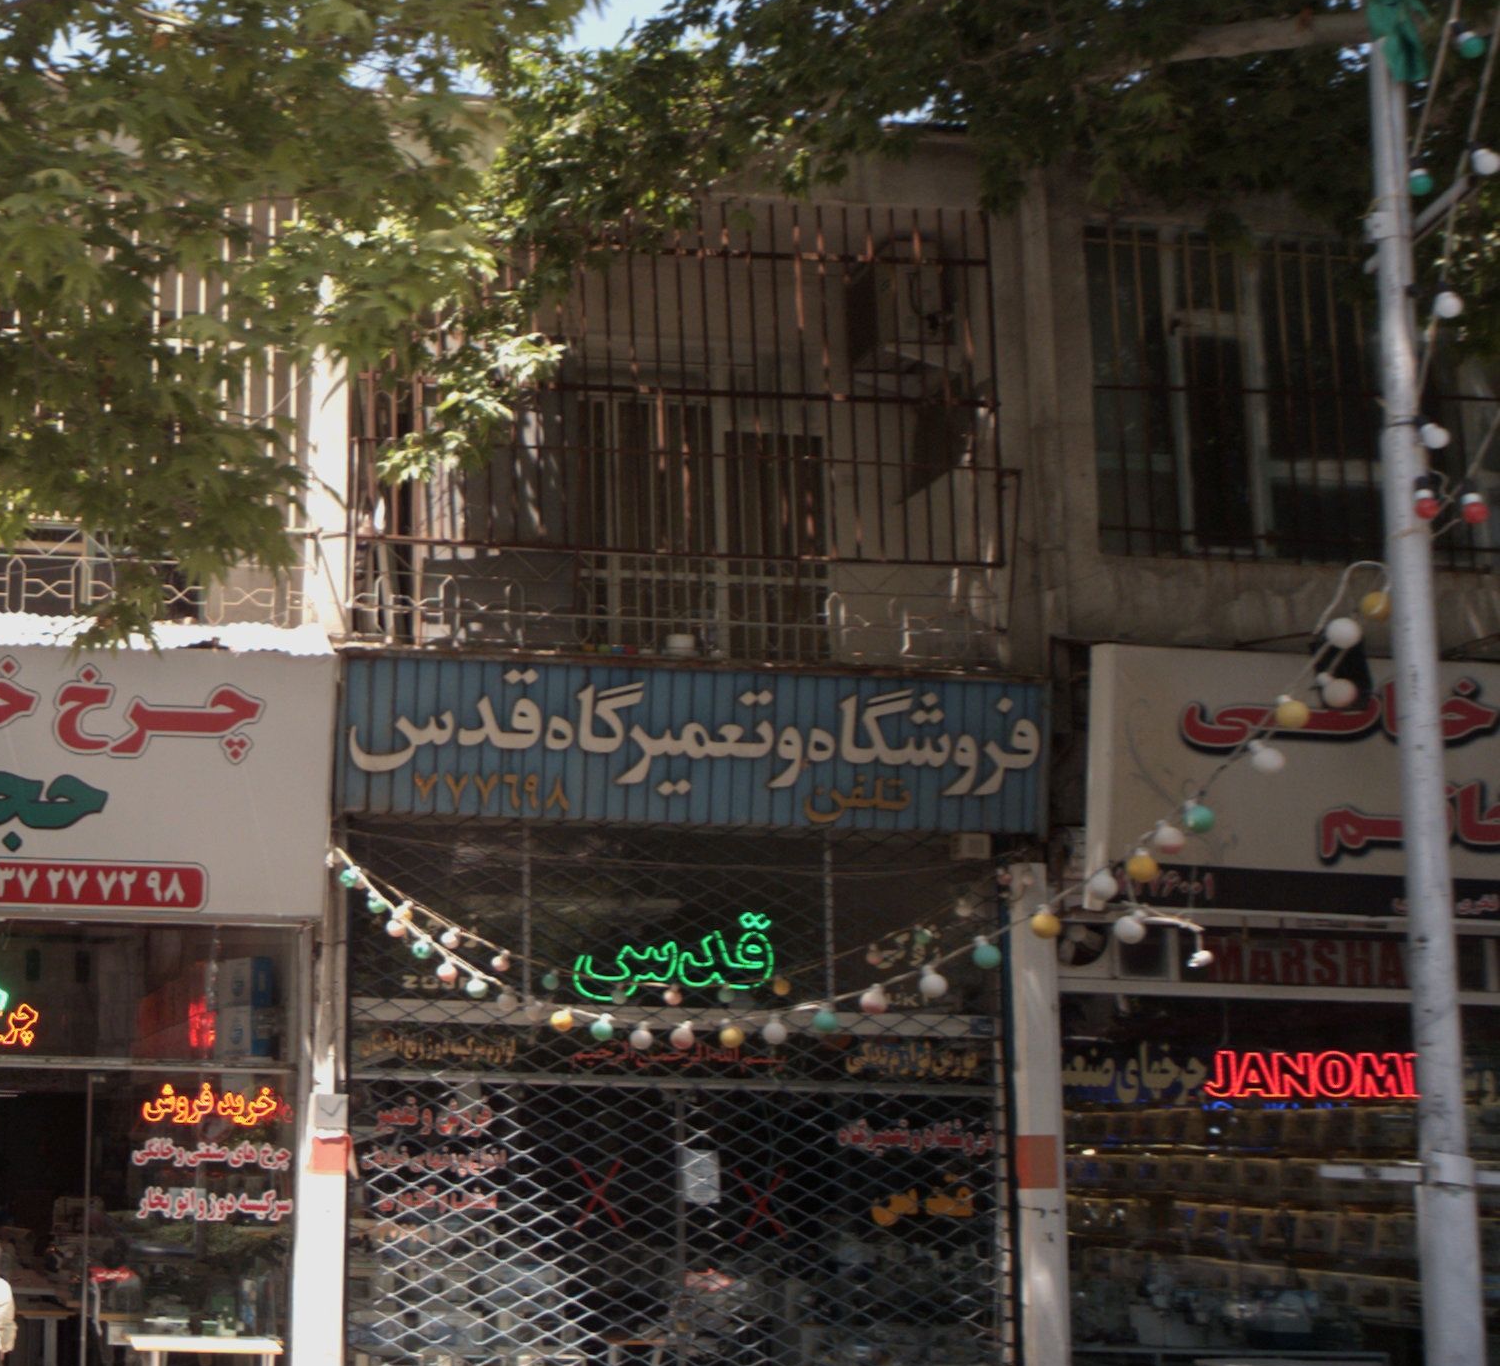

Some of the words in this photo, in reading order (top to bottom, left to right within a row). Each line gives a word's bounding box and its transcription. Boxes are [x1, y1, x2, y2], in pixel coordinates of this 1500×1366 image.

[53, 663, 266, 763] چرخ
[348, 669, 540, 773] قدس
[544, 680, 779, 797] تعمیرگاه
[769, 720, 802, 789] و
[808, 689, 1042, 797] فروشگاه
[804, 774, 912, 823] تلفن
[573, 912, 775, 1001] قدس
[141, 1082, 215, 1124] فروش
[217, 1086, 277, 1125] خرید
[132, 1137, 175, 1166] خانگی
[186, 1141, 229, 1167] صنعتی
[227, 1140, 257, 1167] های
[258, 1142, 292, 1171] چرخ
[136, 1185, 172, 1220] بخار
